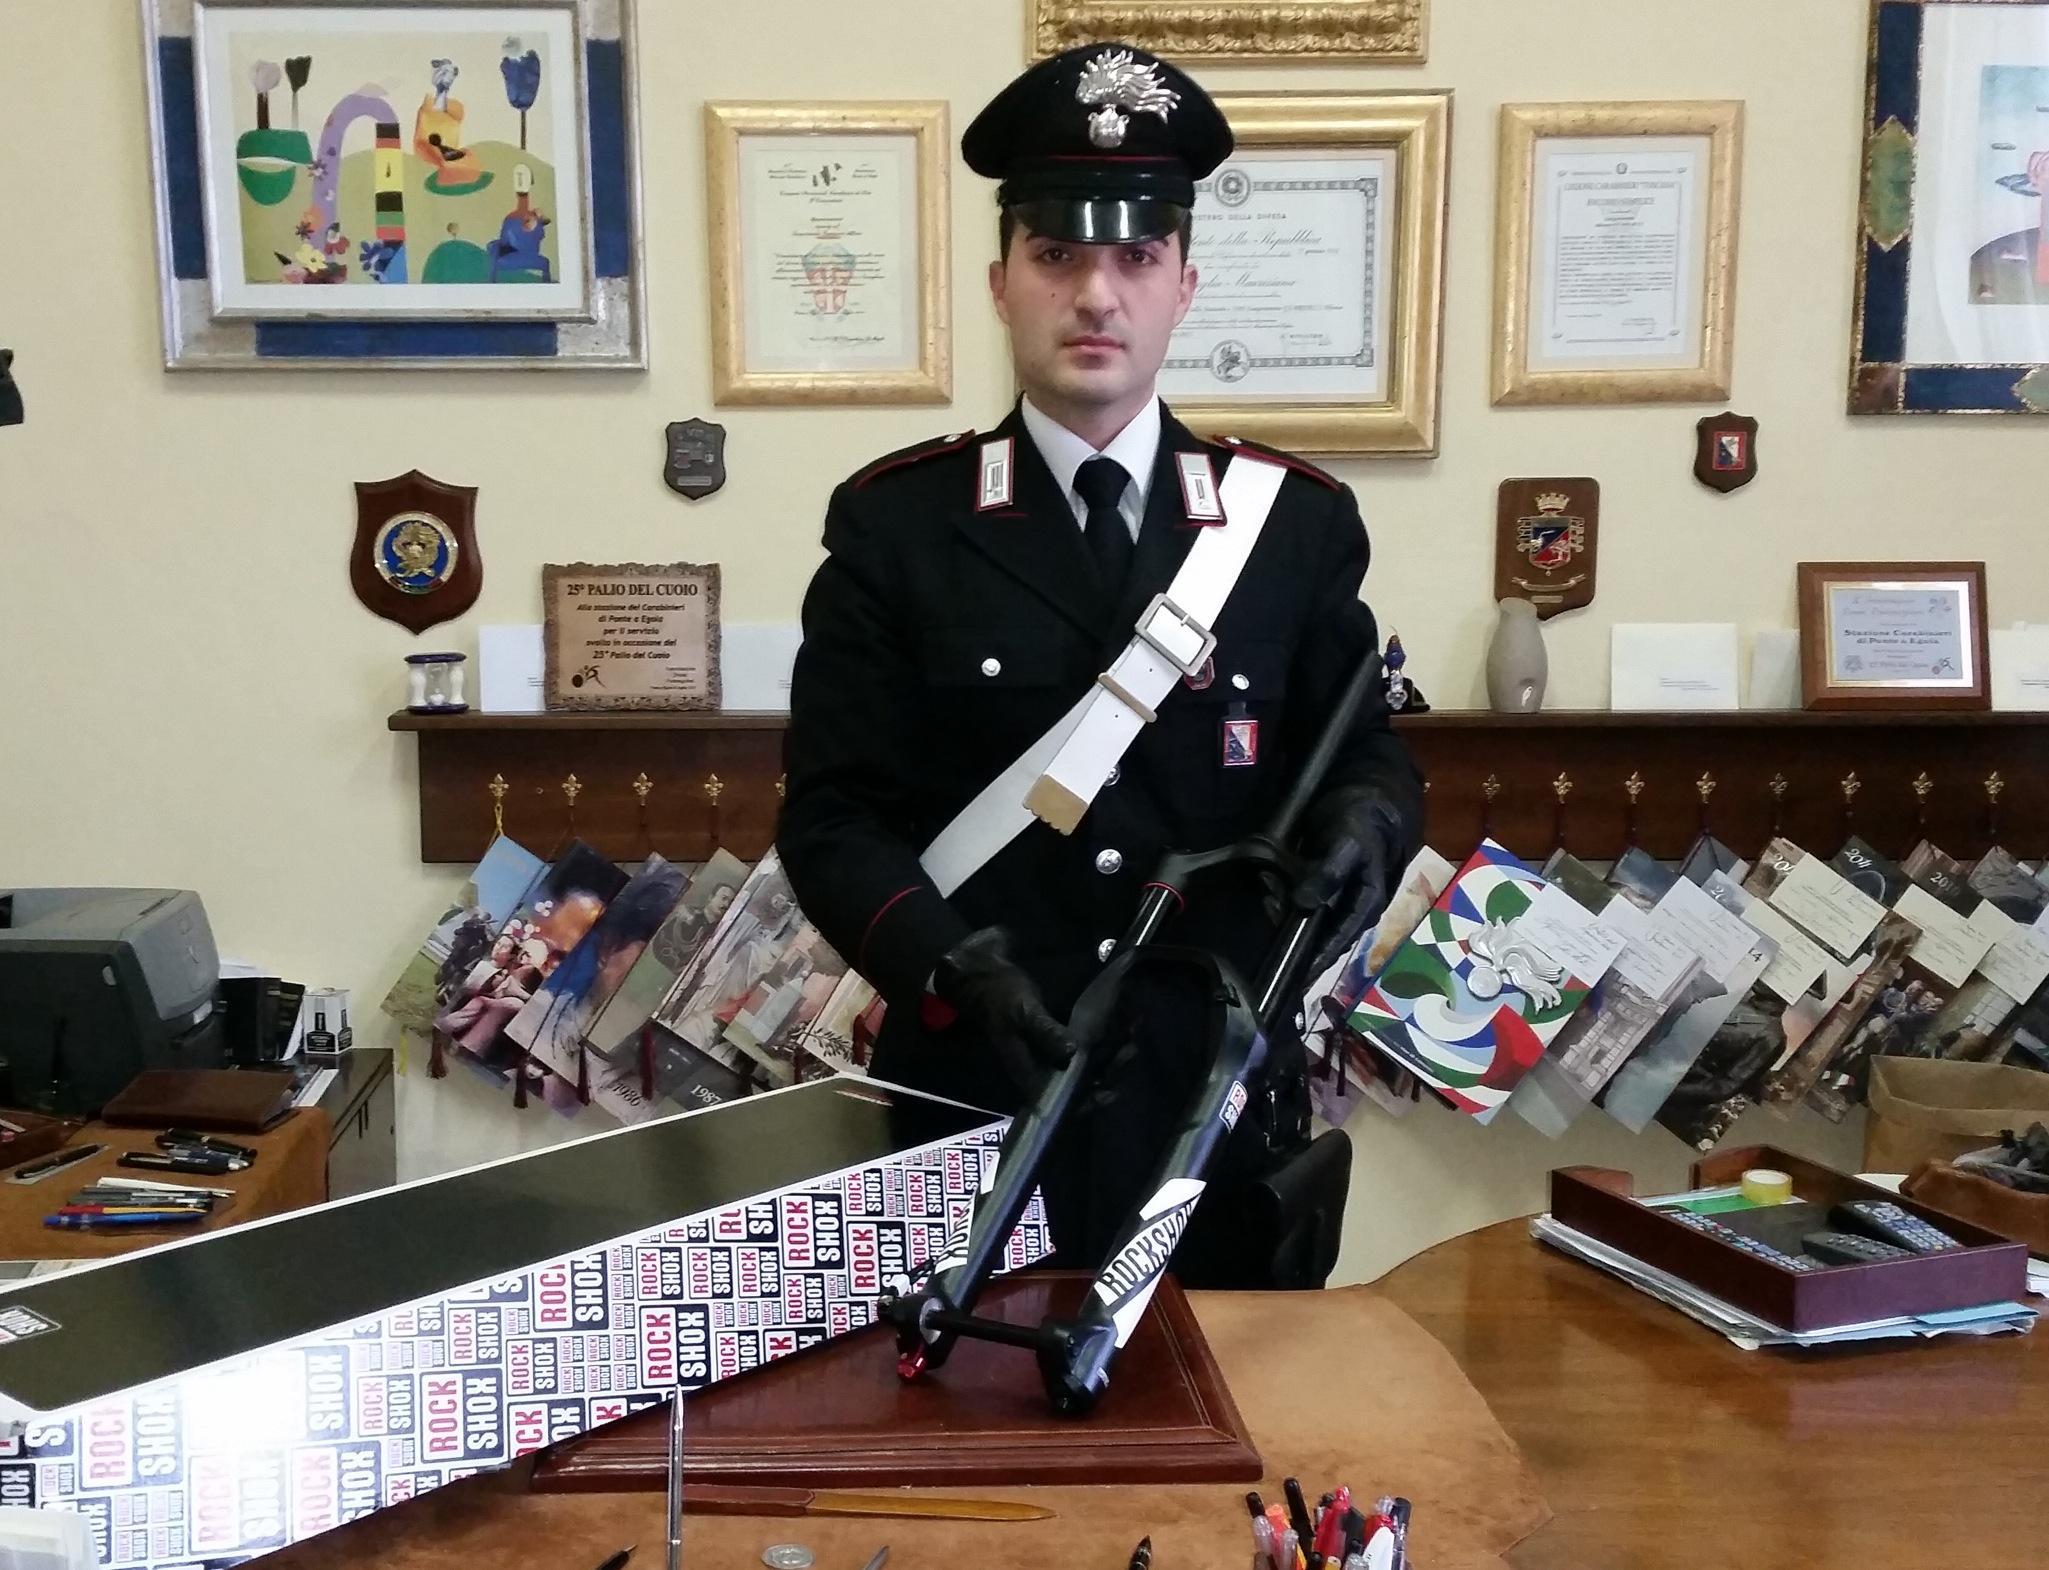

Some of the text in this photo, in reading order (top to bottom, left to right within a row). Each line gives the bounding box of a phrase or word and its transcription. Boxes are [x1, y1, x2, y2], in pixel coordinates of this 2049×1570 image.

[588, 584, 626, 595] PALIO
[628, 584, 654, 595] DEL
[656, 584, 698, 595] CUOIO
[1845, 847, 1873, 870] 2011
[690, 1083, 722, 1106] 1987
[848, 1172, 862, 1211] ROCK
[865, 1172, 881, 1212] SHOX
[910, 1174, 924, 1212] ROCK
[947, 1152, 961, 1190] ROCK
[964, 1152, 978, 1191] SHOX
[927, 1174, 942, 1213] SHOX
[786, 1201, 810, 1261] ROCK
[814, 1200, 841, 1262] SHOX
[641, 1252, 658, 1295] ROCK
[662, 1251, 681, 1296] SHOX
[693, 1252, 709, 1293] ROCK
[712, 1251, 731, 1294] SHOX
[742, 1251, 757, 1293] ROCK
[760, 1250, 779, 1293] SHOX
[852, 1228, 876, 1288] ROCK
[787, 1278, 803, 1318] ROCK
[806, 1277, 823, 1319] SHOX
[454, 1312, 473, 1360] ROCK
[478, 1311, 500, 1360] SHOX
[647, 1313, 673, 1379] ROCK
[678, 1311, 707, 1378] SHOX
[512, 1344, 530, 1390] ROCK
[534, 1343, 555, 1390] SHOX
[308, 1353, 344, 1433] SHOX
[363, 1381, 383, 1431] ROCK
[389, 1379, 412, 1430] SHOX
[466, 1376, 499, 1451] SHOX
[428, 1380, 459, 1453] ROCK
[301, 1453, 332, 1532] ROCK
